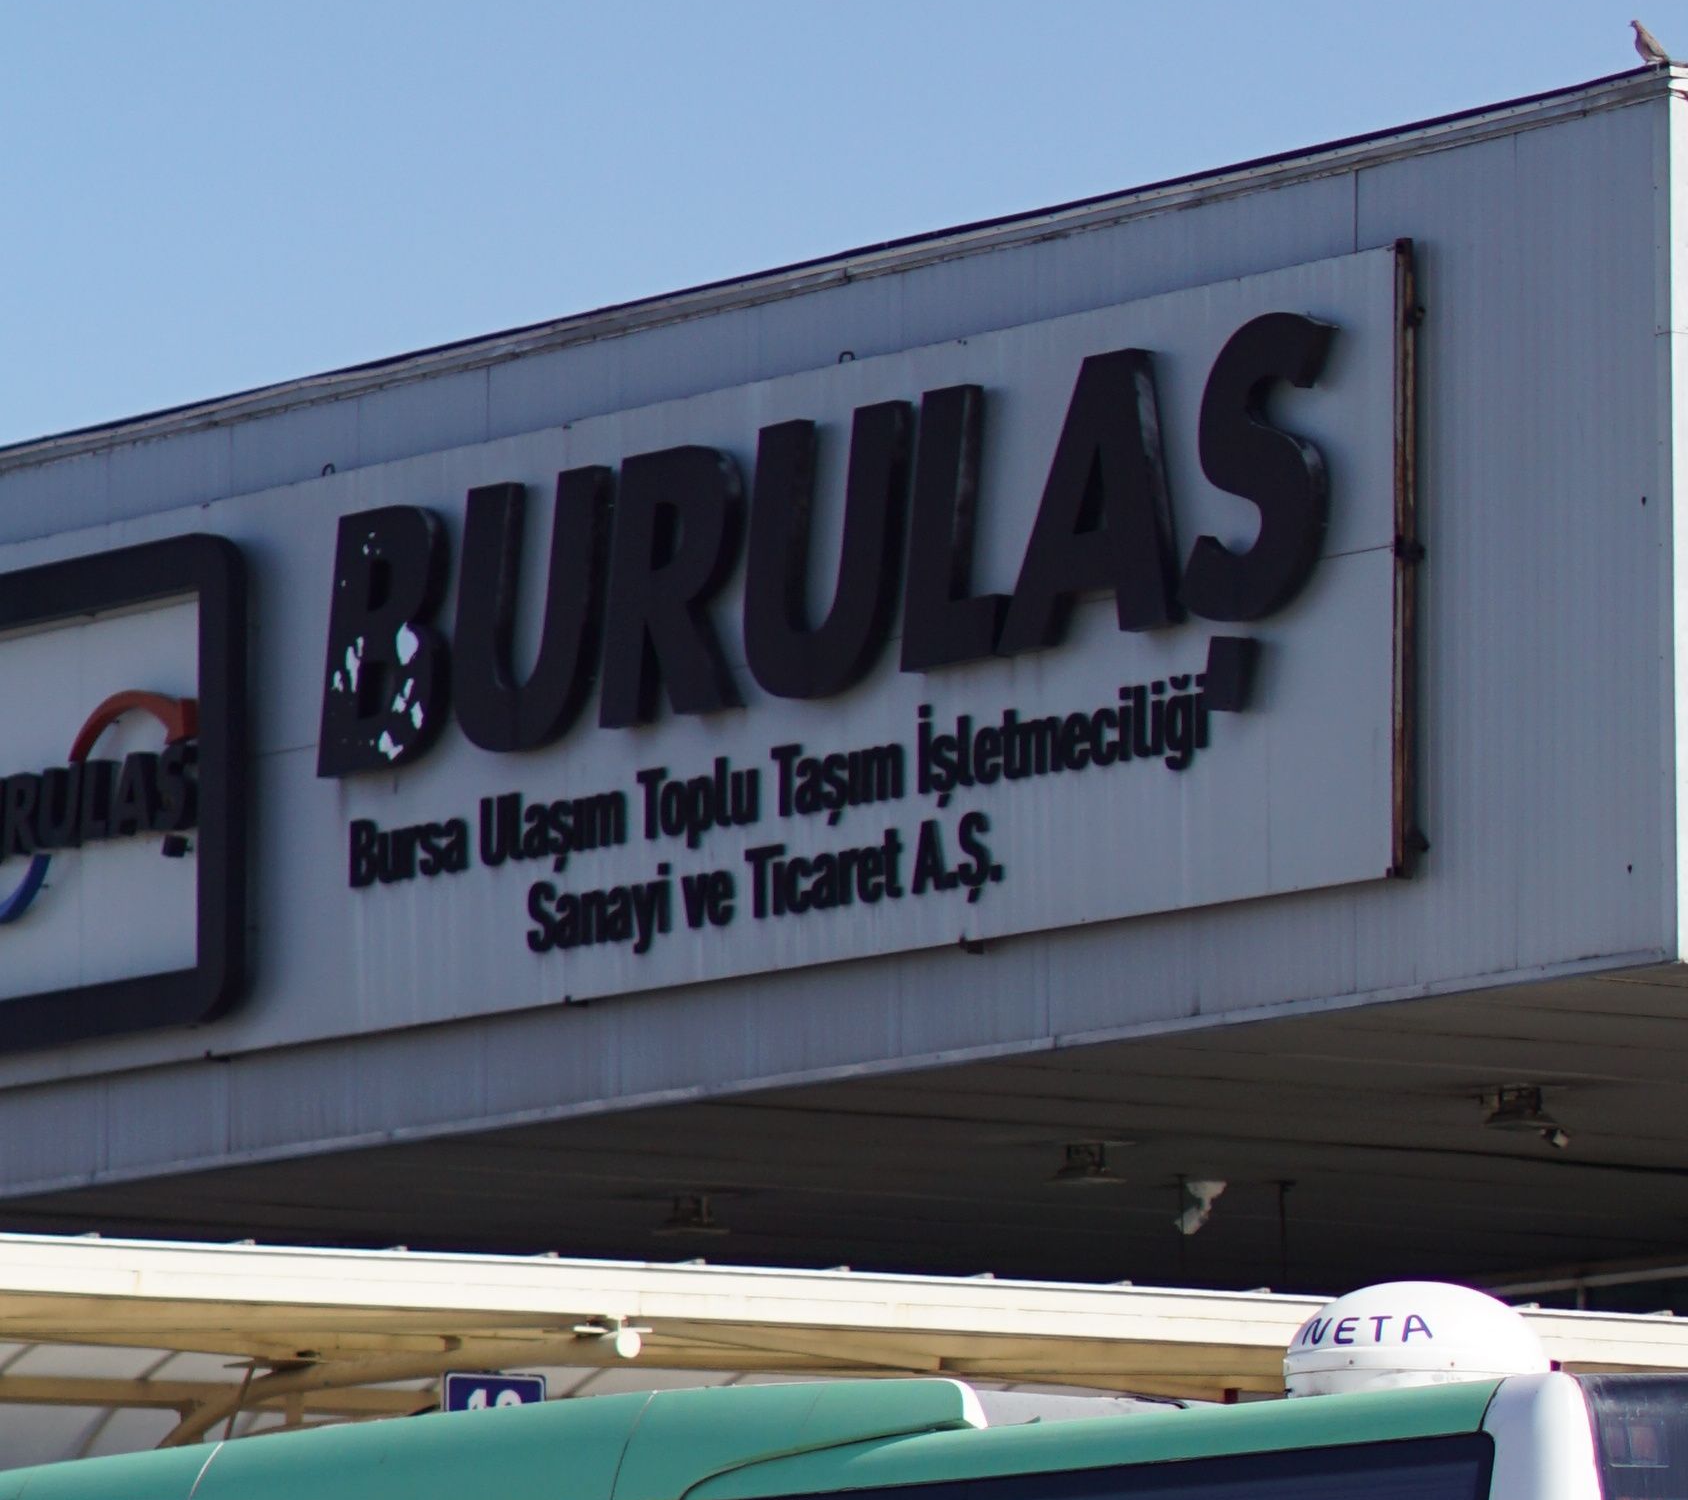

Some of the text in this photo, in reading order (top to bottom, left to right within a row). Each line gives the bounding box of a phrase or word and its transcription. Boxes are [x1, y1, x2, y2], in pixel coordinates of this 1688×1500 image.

[317, 312, 1339, 779] BURULAŞ
[0, 743, 198, 860] RULAŞ
[348, 673, 1212, 888] Bursa Ulaşım Toplu Taşım İşletmeciliği
[527, 862, 672, 954] Sanayi
[681, 869, 736, 929] ve
[912, 811, 1005, 904] A.Ş.
[1301, 1314, 1434, 1346] NETA
